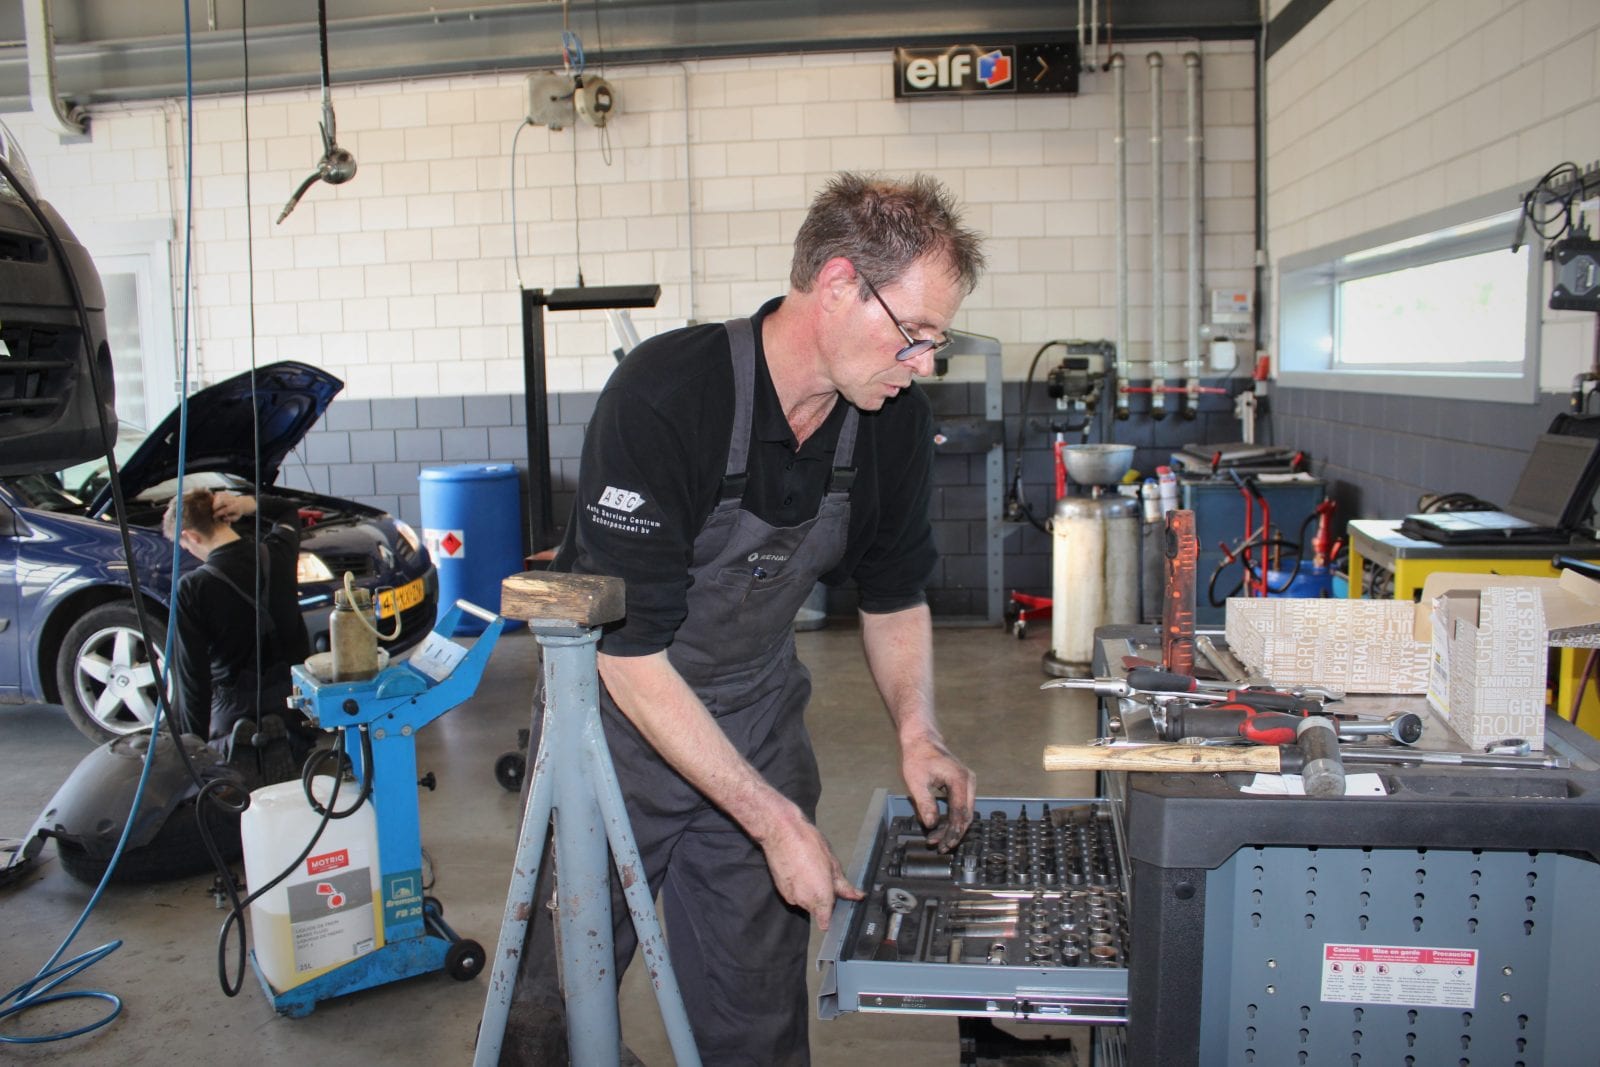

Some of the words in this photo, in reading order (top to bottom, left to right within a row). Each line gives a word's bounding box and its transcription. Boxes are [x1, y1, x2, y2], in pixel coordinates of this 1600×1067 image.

[906, 54, 971, 89] elf
[602, 491, 638, 509] ASC
[586, 503, 599, 514] Auto
[601, 509, 627, 522] Service
[629, 516, 661, 528] Centrum
[1333, 641, 1348, 673] PIEC
[311, 855, 344, 868] MOTRIO
[1432, 950, 1472, 958] Precaución
